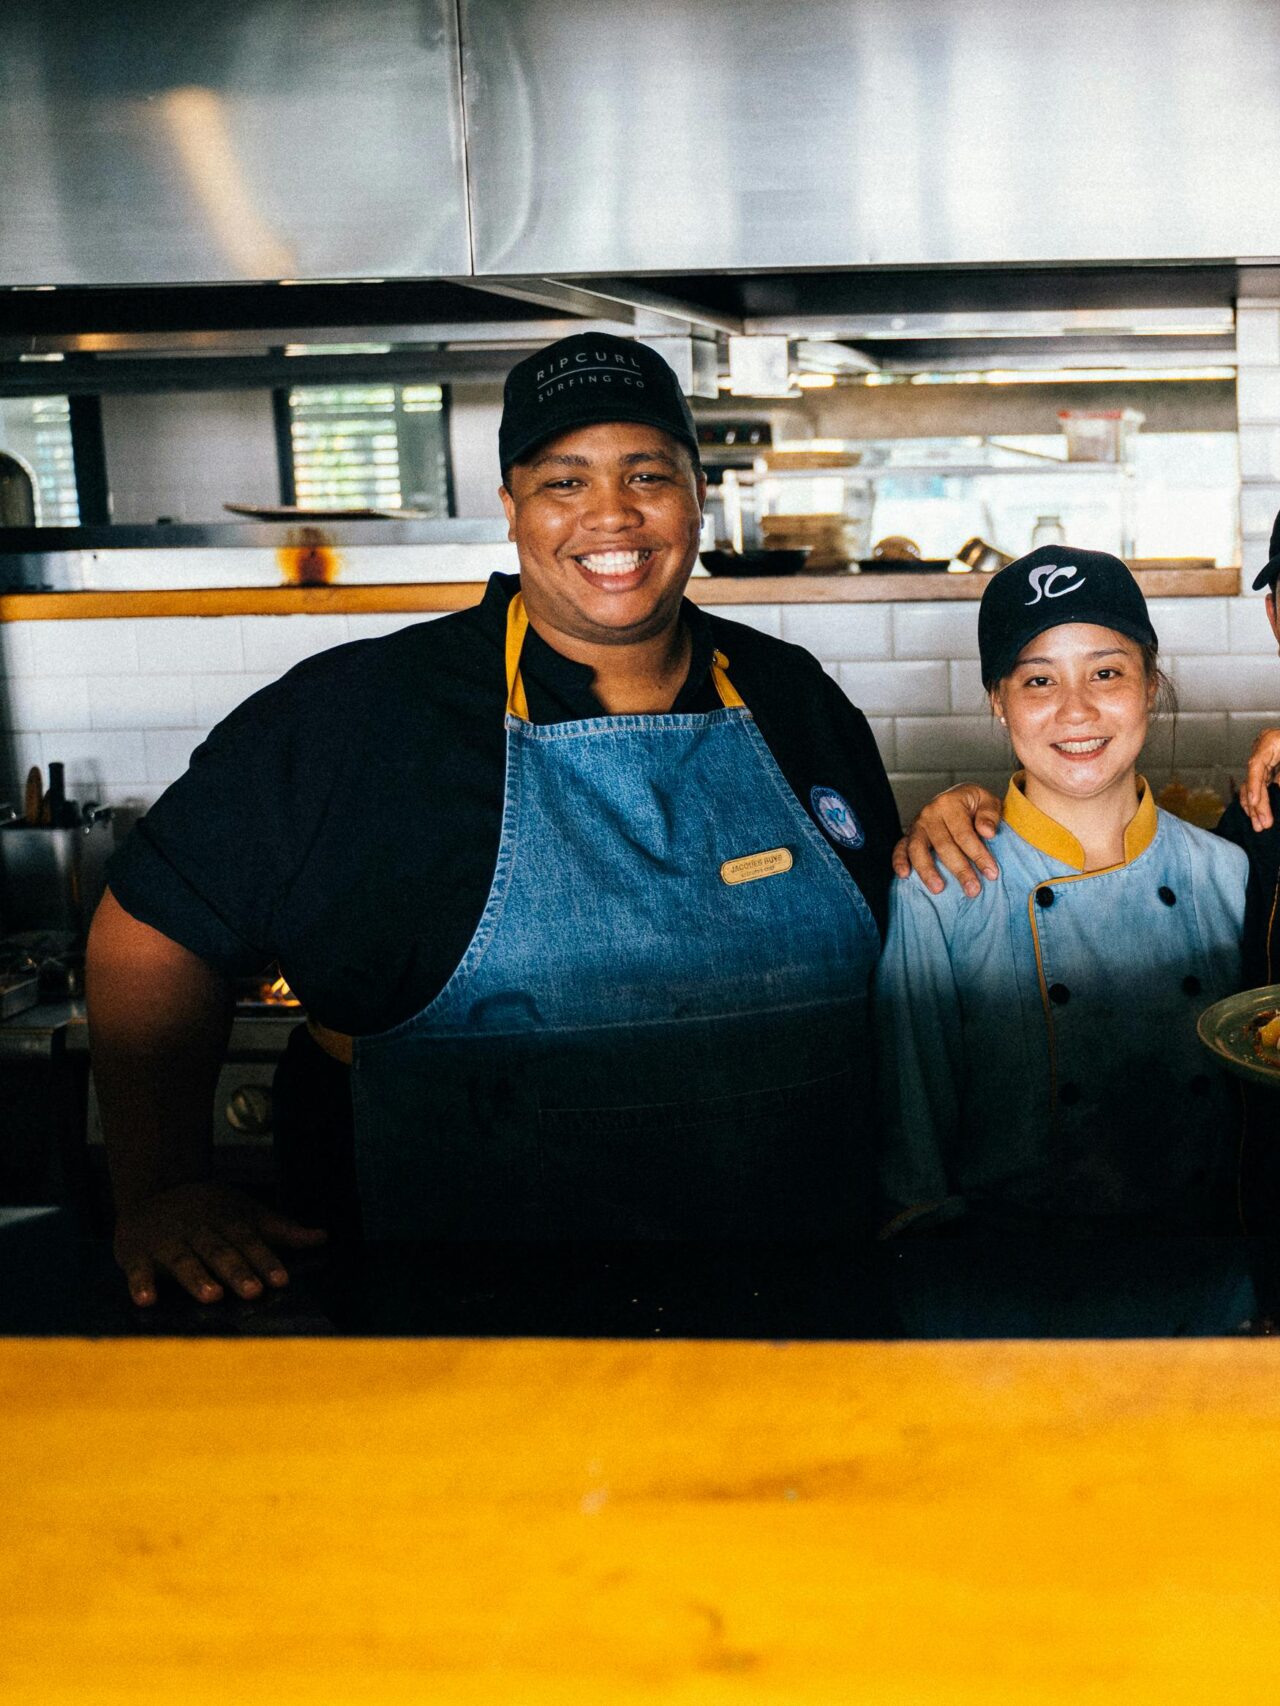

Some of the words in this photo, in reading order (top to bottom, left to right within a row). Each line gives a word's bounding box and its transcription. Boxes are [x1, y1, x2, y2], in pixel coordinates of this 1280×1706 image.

[536, 351, 641, 382] RIPCURL
[538, 374, 612, 402] SURFING
[623, 376, 645, 389] CO
